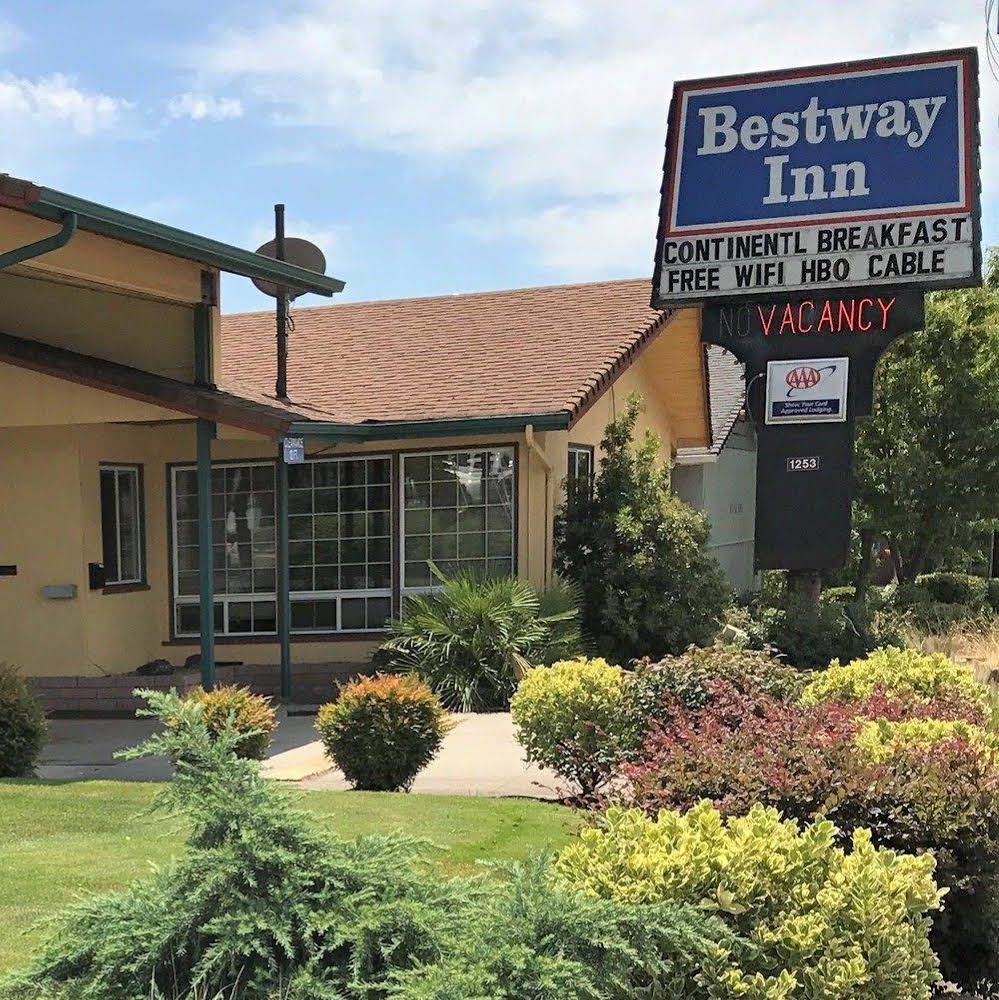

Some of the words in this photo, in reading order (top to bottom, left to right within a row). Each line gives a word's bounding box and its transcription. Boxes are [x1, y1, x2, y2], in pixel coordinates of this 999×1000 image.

[697, 96, 947, 156] Bestway
[762, 154, 870, 205] Inn
[664, 231, 807, 264] CONTINENTL
[816, 217, 967, 252] BREAKFAST
[668, 267, 720, 293] FREE
[735, 261, 784, 288] WIFI
[801, 256, 851, 283] HBO
[868, 249, 946, 277] CABLE
[720, 307, 750, 337] NO
[757, 297, 896, 336] VACANCY
[787, 366, 820, 389] AAA
[789, 459, 817, 469] 1253
